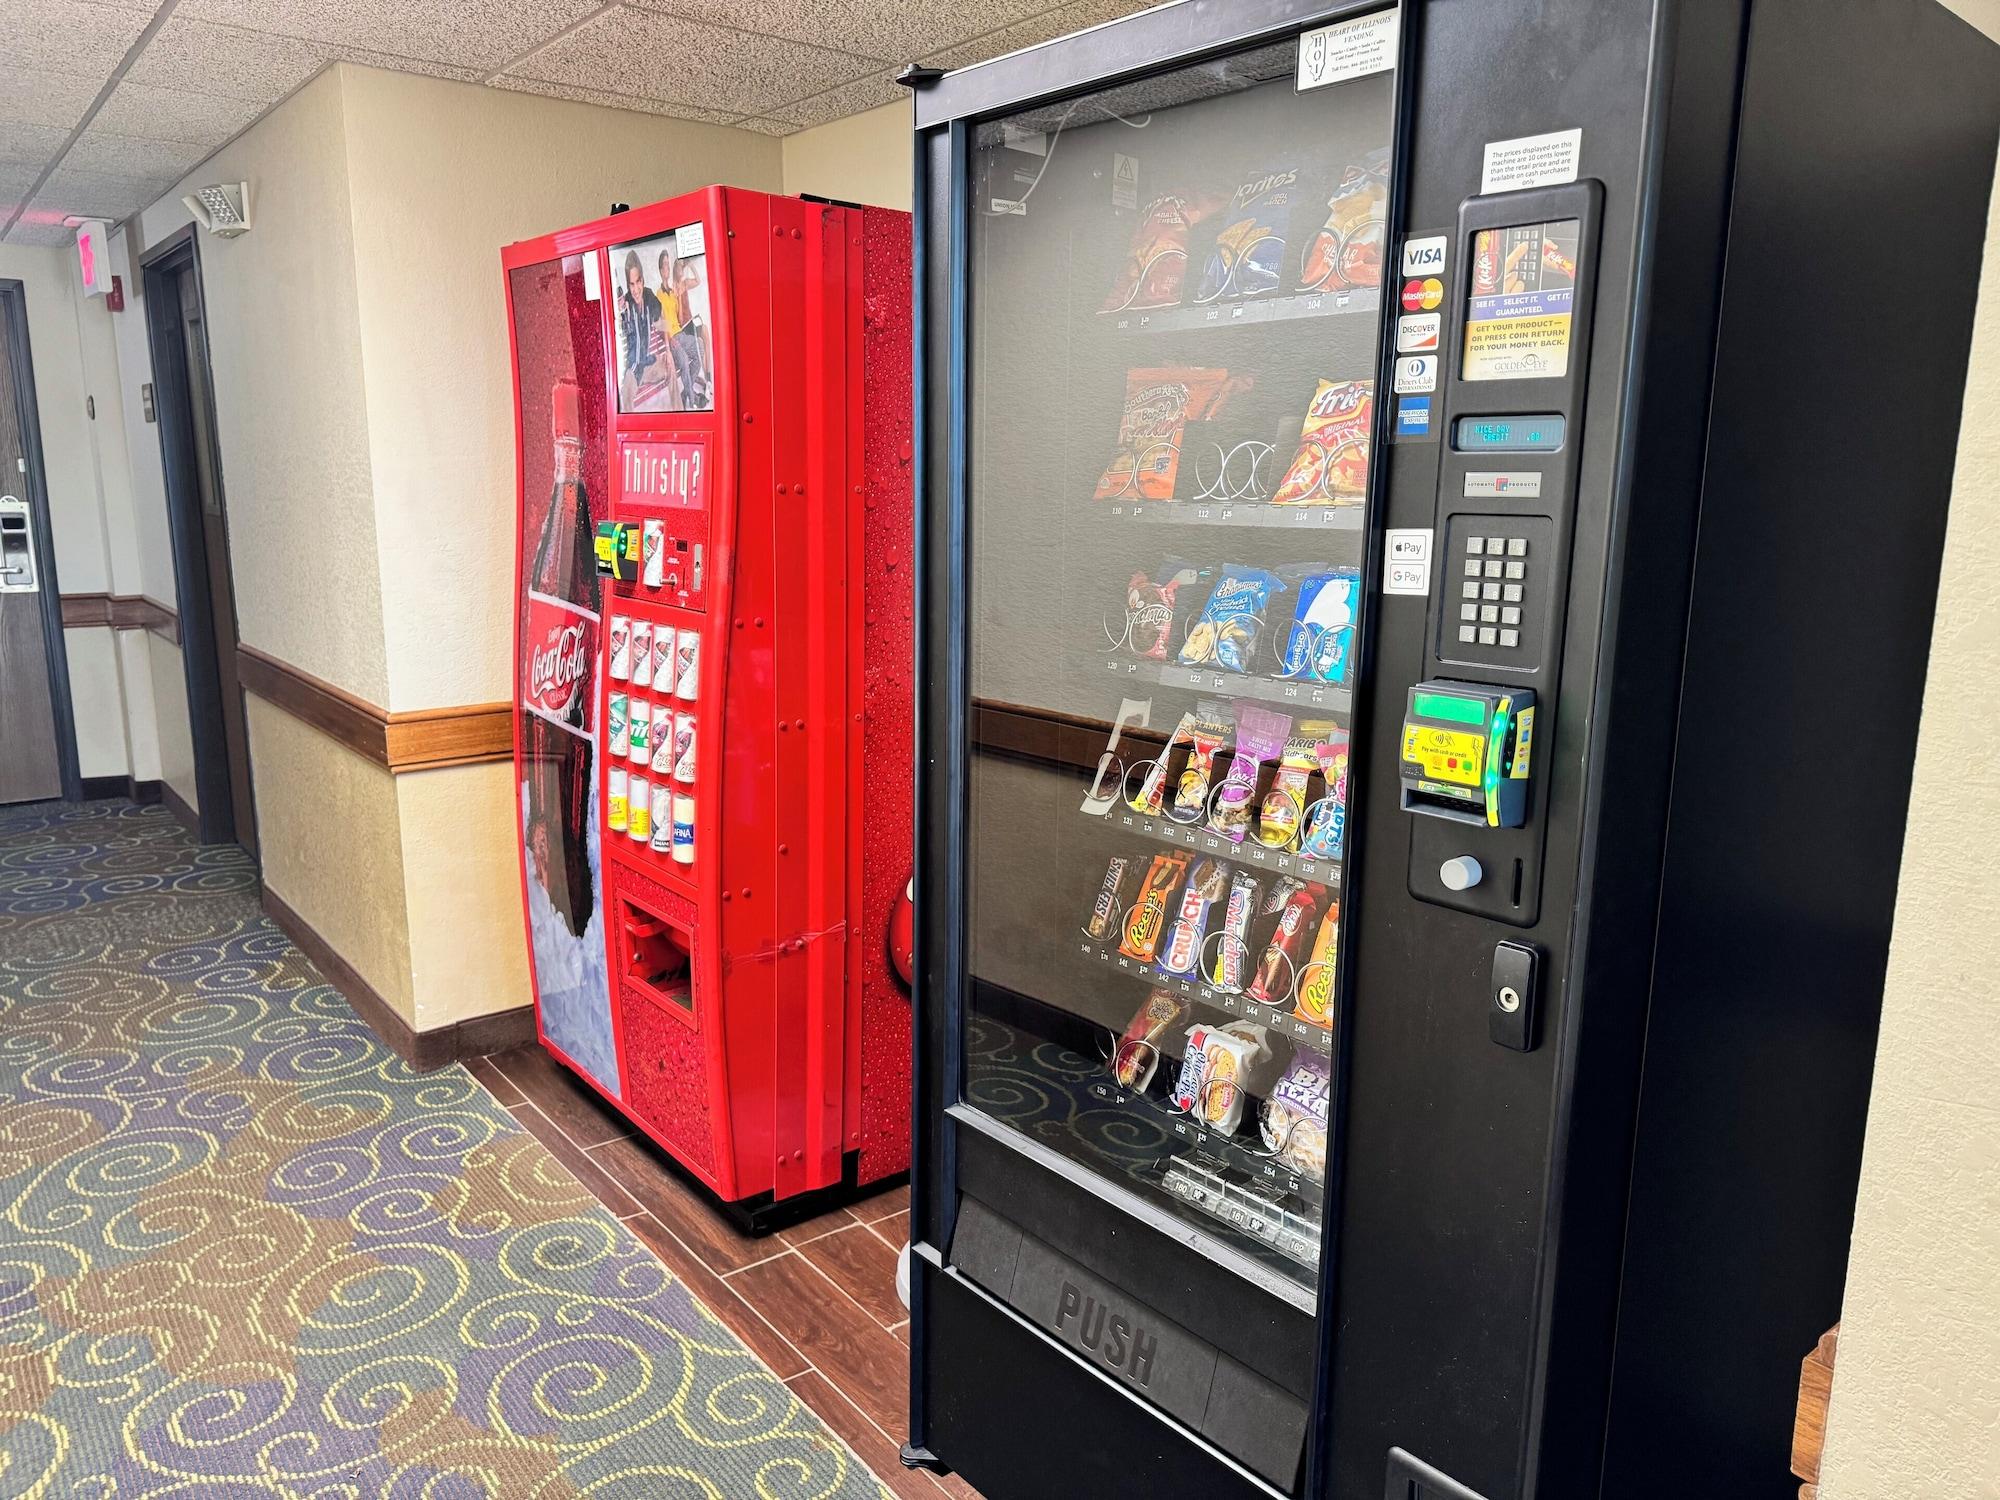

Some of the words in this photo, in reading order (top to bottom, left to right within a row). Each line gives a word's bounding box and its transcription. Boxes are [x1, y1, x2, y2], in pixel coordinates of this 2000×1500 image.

[1328, 27, 1350, 38] HEART
[1351, 24, 1361, 32] OF
[1362, 16, 1391, 30] ILLINOIS
[1344, 29, 1374, 43] VENDING
[1504, 150, 1521, 158] prices
[1523, 144, 1550, 154] displayed
[1561, 141, 1572, 149] this
[1492, 158, 1516, 166] machine
[1516, 163, 1531, 171] retail
[1532, 162, 1547, 170] price
[1490, 174, 1515, 182] available
[1540, 166, 1570, 176] purchases
[1408, 248, 1442, 265] VISA
[1307, 299, 1320, 309] 104
[1503, 297, 1529, 306] SELECT
[1207, 311, 1218, 320] 102
[1496, 306, 1543, 316] GUARANTEED.
[1402, 324, 1435, 334] DISCOVER
[1492, 323, 1513, 331] YOUR
[1509, 332, 1528, 340] COIN
[1531, 329, 1565, 338] RETURN
[1509, 341, 1537, 349] MONEY
[1398, 377, 1417, 386] Diners
[1418, 376, 1433, 385] Club
[1324, 416, 1364, 437] ORIGINAL
[1475, 425, 1492, 433] NICE
[1496, 425, 1510, 433] DAY
[1483, 433, 1509, 441] CREDIT
[624, 449, 700, 505] Thirsty?
[1198, 510, 1209, 518] 112
[1295, 512, 1308, 521] 114
[1404, 543, 1422, 554] Pay
[1404, 571, 1422, 583] Pay
[1292, 631, 1306, 672] Original
[1107, 661, 1118, 669] 120
[1285, 688, 1297, 696] 124
[1196, 720, 1233, 734] PLANTERS
[1248, 741, 1261, 750] SALTY
[1262, 745, 1272, 753] MIX
[1123, 817, 1133, 825] 131
[1164, 827, 1174, 836] 132
[1207, 838, 1218, 848] 133
[1252, 850, 1265, 860] 134
[1302, 863, 1315, 873] 135
[1130, 888, 1158, 949] Reese's
[1172, 892, 1201, 969] CRUNCH
[1081, 944, 1091, 953] 140
[1225, 902, 1242, 985] Musketeers
[1119, 959, 1128, 967] 141
[1158, 973, 1169, 982] 142
[1201, 989, 1212, 998] 143
[1246, 1005, 1258, 1016] 144
[1295, 1023, 1307, 1034] 145
[1097, 1086, 1106, 1095] 150
[1278, 1080, 1329, 1121] TEXA
[1279, 1095, 1311, 1117] cinnamon
[1175, 1124, 1186, 1134] 152
[1264, 1166, 1275, 1177] 154
[1175, 1182, 1187, 1194] 160
[1231, 1212, 1244, 1223] 161
[1291, 1239, 1304, 1252] 162
[1054, 1280, 1158, 1389] PUSH
